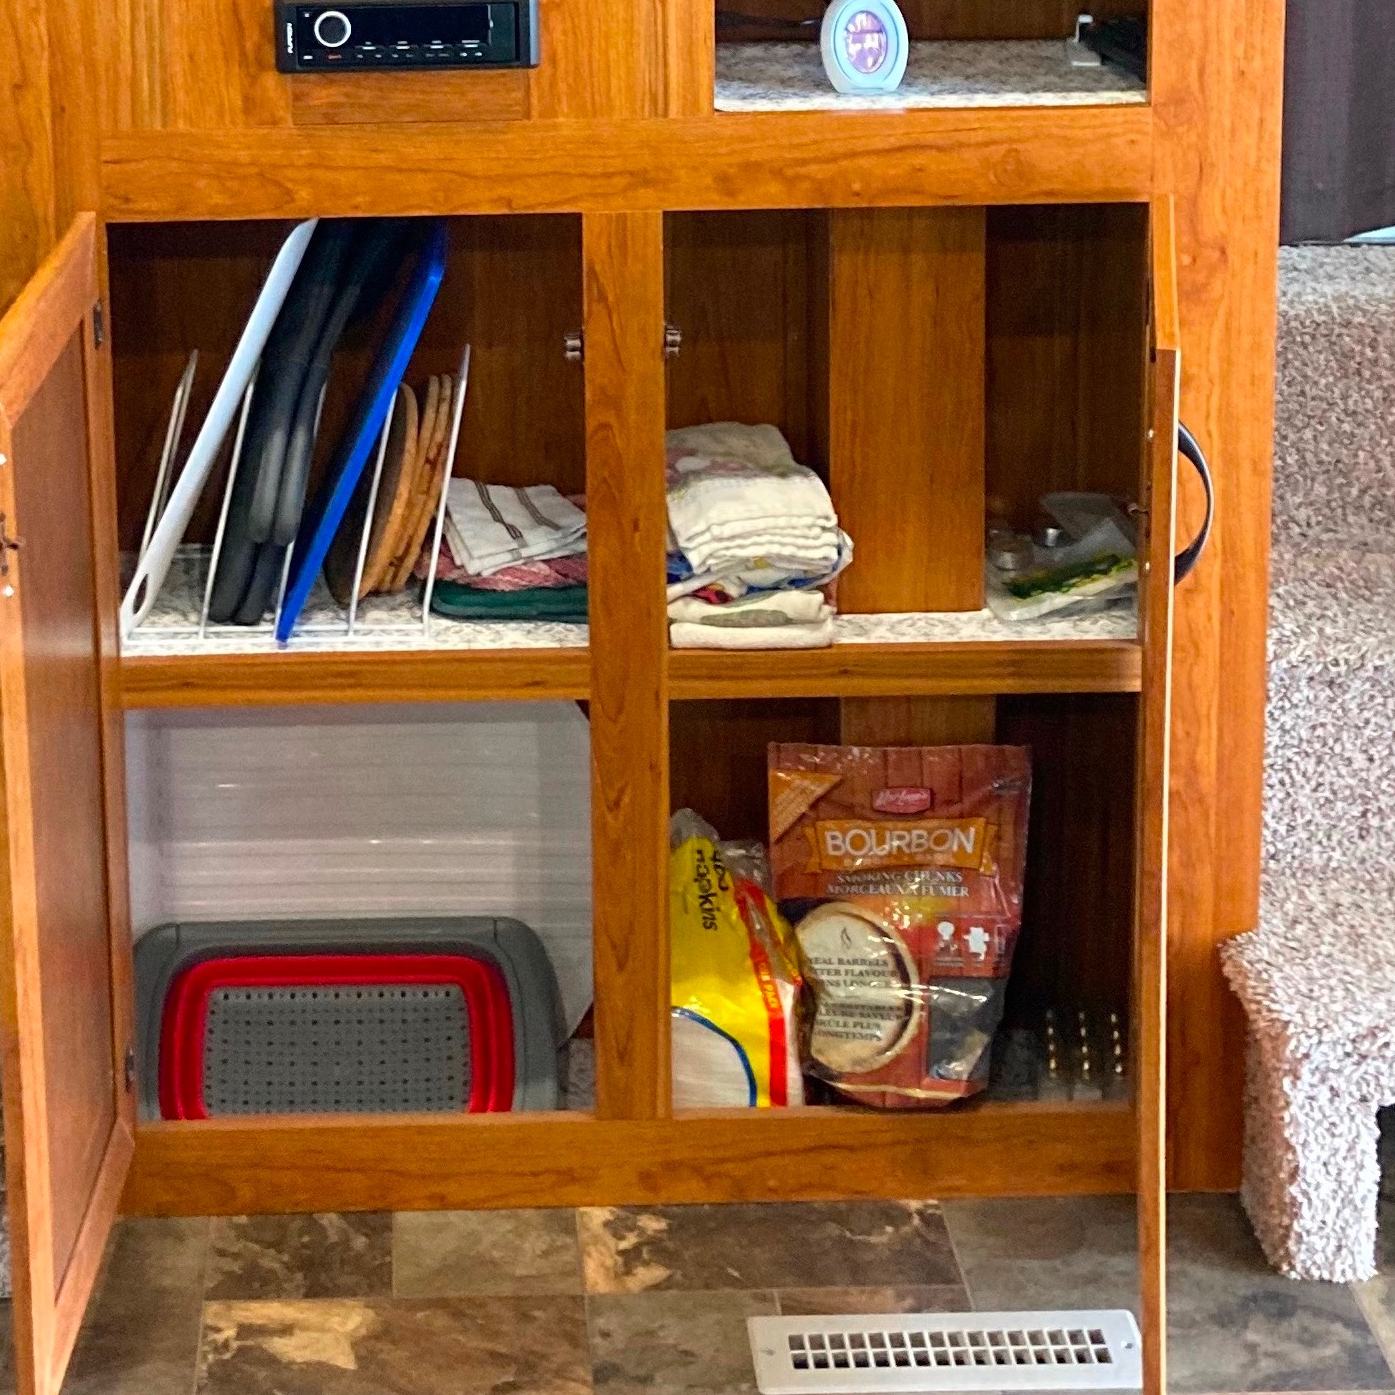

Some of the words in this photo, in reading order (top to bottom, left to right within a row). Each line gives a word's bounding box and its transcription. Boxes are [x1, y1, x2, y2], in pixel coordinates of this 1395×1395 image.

[824, 826, 975, 856] BOURBON
[837, 870, 902, 883] SMOKING
[694, 849, 721, 932] napkins
[922, 885, 969, 897] FUMER
